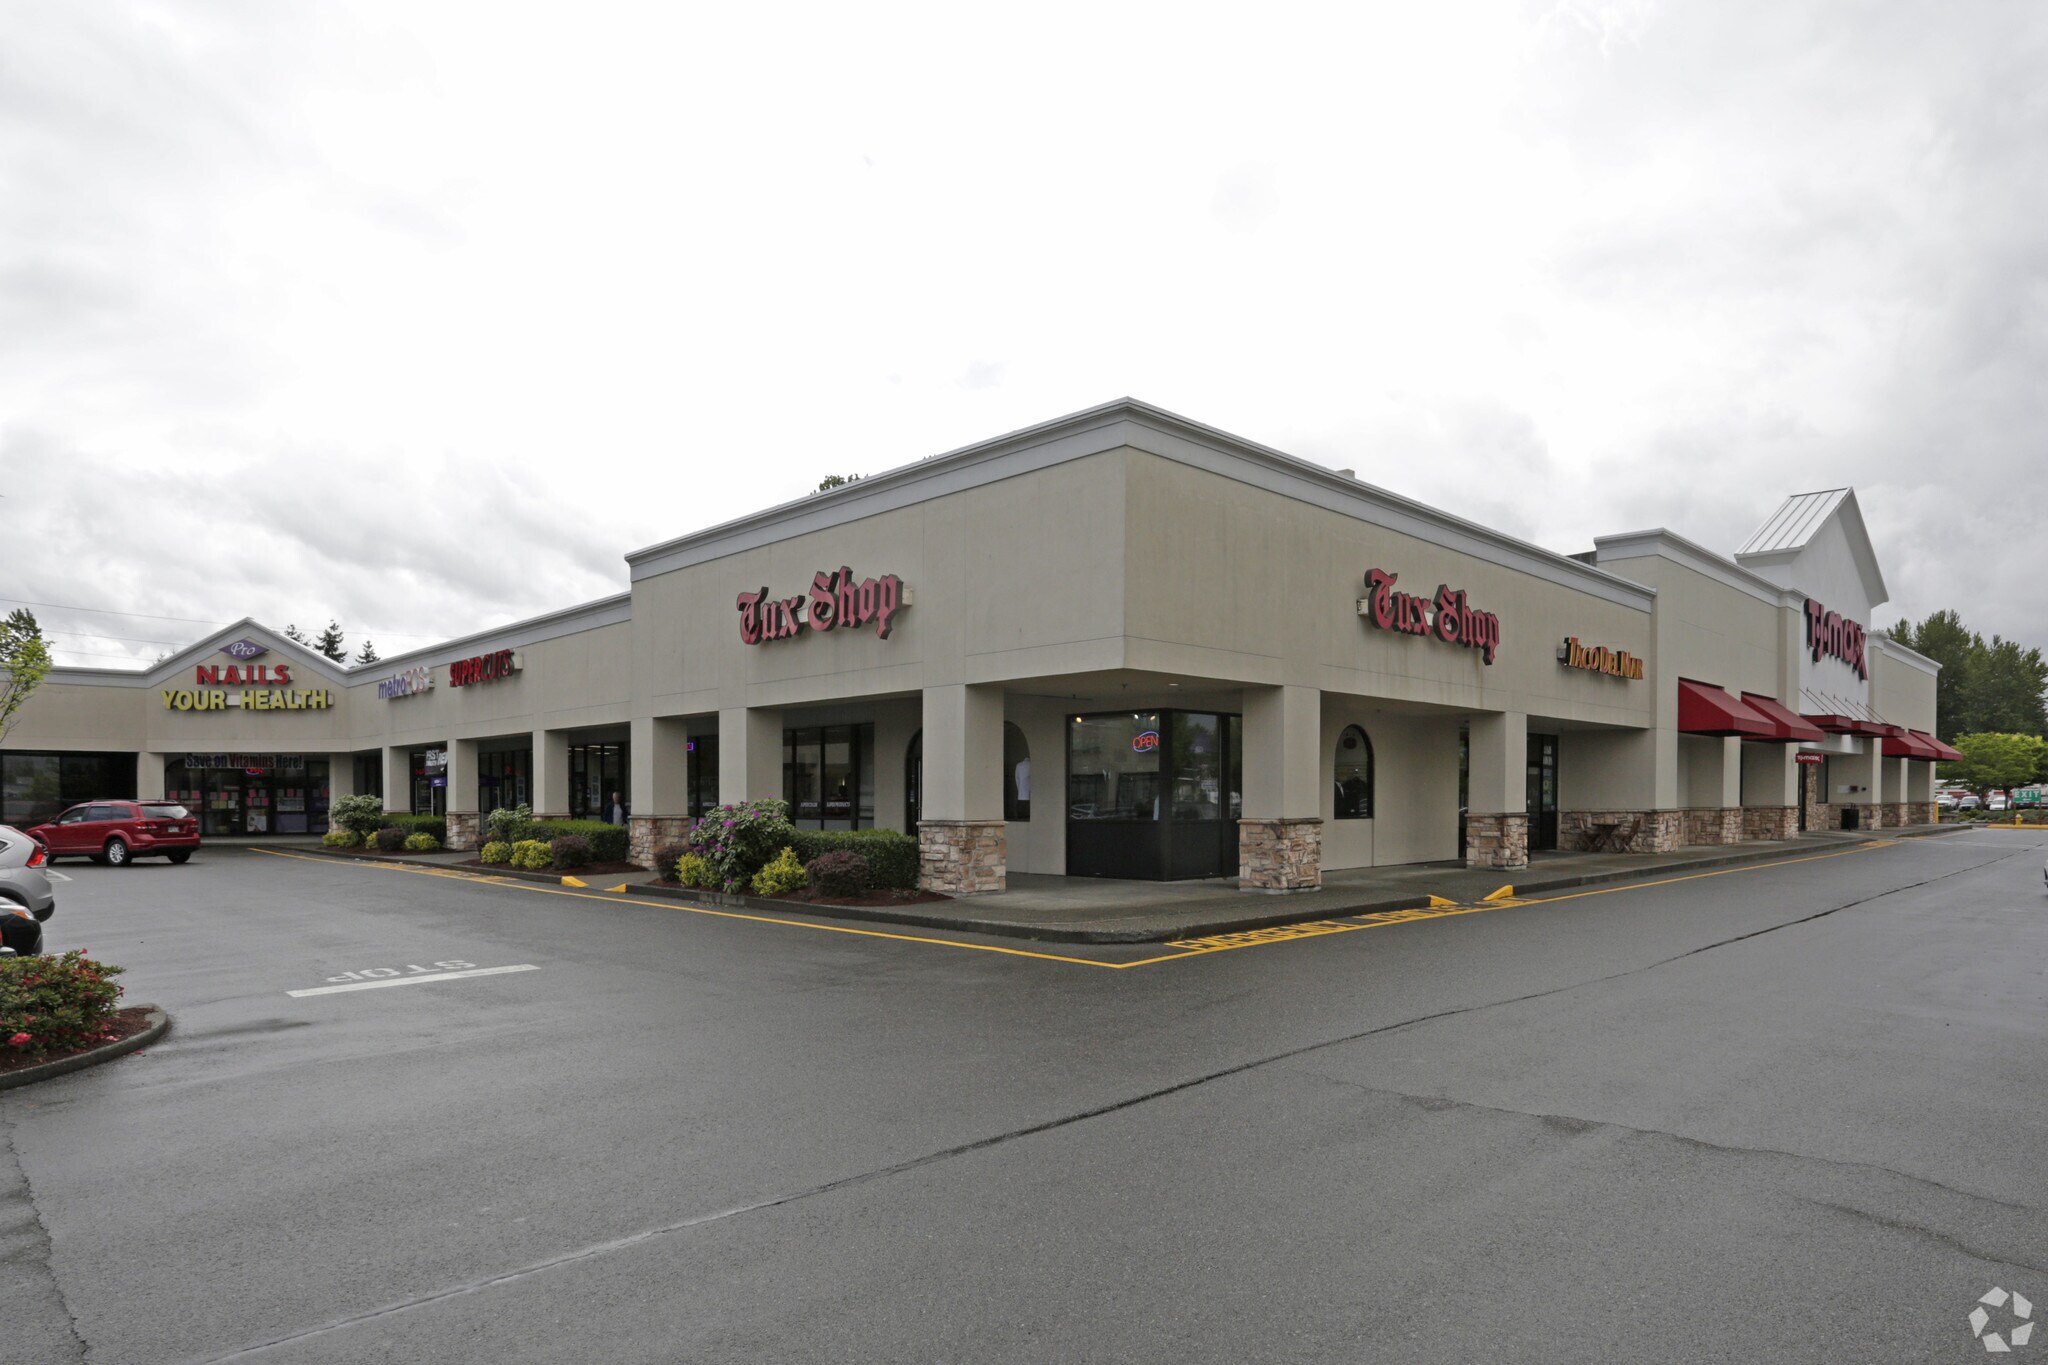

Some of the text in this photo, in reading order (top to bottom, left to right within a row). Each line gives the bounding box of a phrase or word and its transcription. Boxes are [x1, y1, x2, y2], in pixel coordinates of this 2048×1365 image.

[737, 565, 904, 645] Tux Shop
[1364, 568, 1500, 666] Tux Shop
[230, 642, 256, 656] Pro
[196, 664, 290, 686] NAILS
[449, 648, 515, 688] SUPERCUTS
[160, 689, 329, 711] YOUR HEALTH
[1132, 735, 1160, 749] OPEN
[186, 753, 212, 768] Save
[213, 756, 228, 768] on
[229, 753, 274, 768] Vitamins
[2014, 789, 2039, 799] EXIT
[326, 959, 477, 983] STOP
